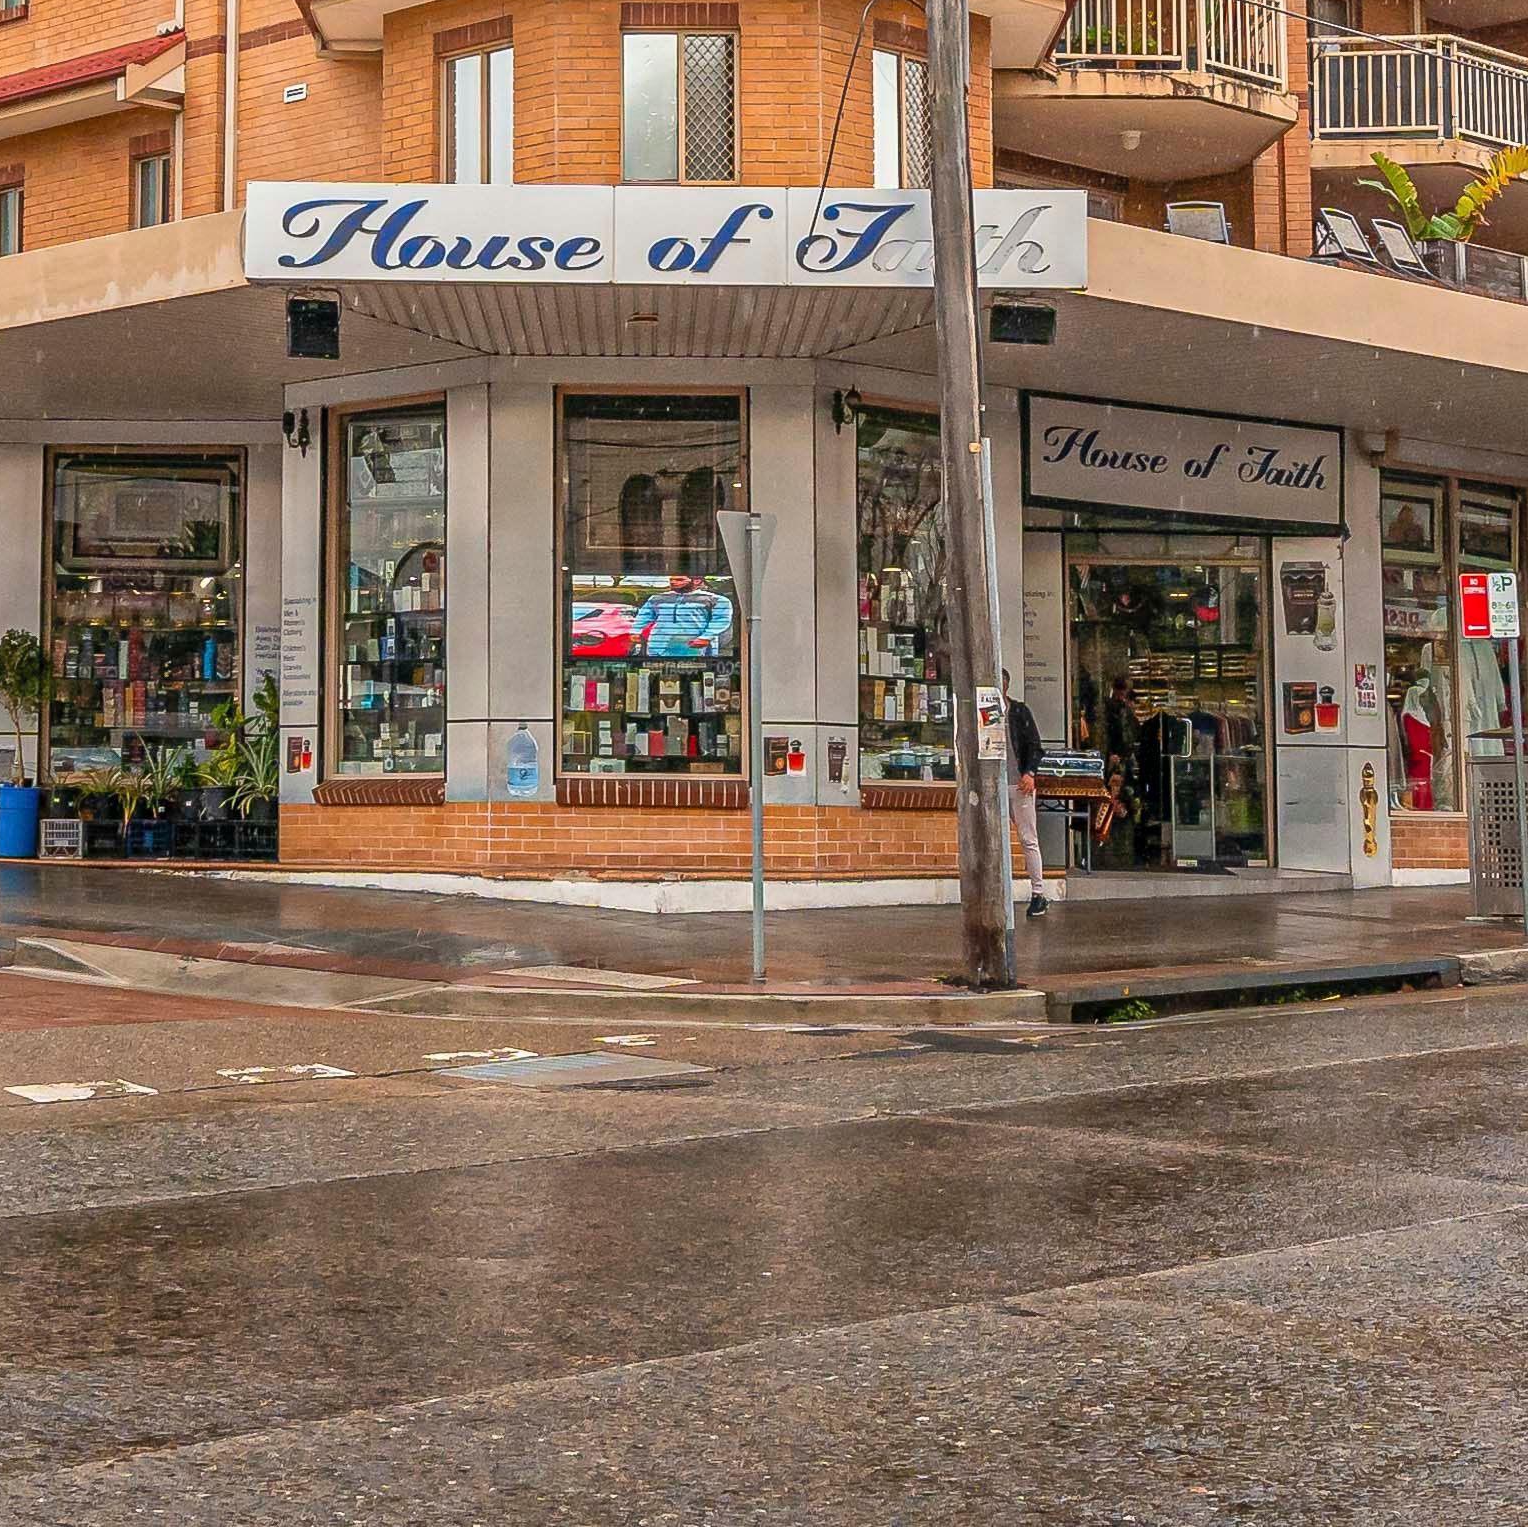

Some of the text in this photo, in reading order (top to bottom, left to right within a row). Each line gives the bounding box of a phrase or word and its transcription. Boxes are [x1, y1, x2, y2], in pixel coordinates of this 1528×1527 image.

[277, 199, 1052, 276] House of Fath
[1042, 425, 1327, 491] House of Faith
